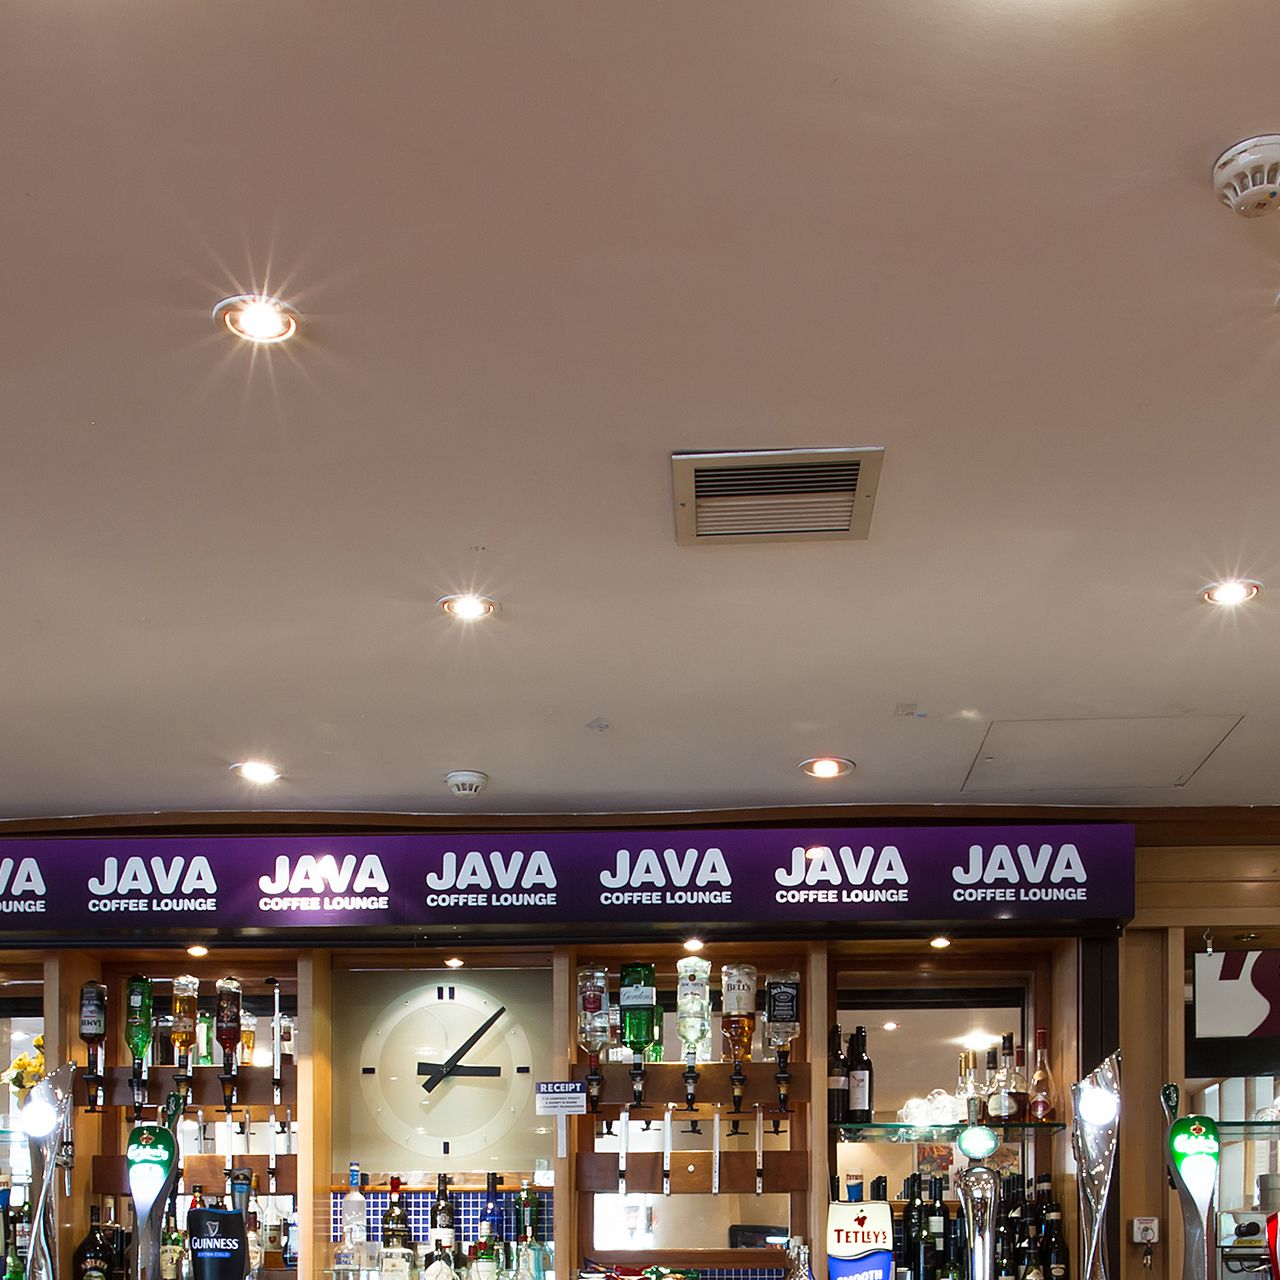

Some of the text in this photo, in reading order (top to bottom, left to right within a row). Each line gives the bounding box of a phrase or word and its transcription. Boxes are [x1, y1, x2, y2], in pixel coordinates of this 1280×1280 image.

[426, 851, 558, 890] JAVA
[600, 848, 732, 888] JAVA
[774, 845, 909, 886] JAVA
[952, 844, 1087, 884] JAVA
[88, 856, 218, 895] JAVA
[258, 854, 390, 894] JAVA
[426, 892, 557, 906] COFFEE LOUNGE
[600, 891, 732, 904] COFFEE LOUNGE
[775, 889, 908, 903] COFFEE LOUNGE
[952, 888, 1087, 901] COFFEE LOUNGE
[88, 898, 217, 912] COFFEE LOUNGE
[258, 896, 389, 910] COFFEE LOUNGE
[540, 1083, 582, 1093] RECEIPT
[192, 1236, 239, 1250] GUINNESS
[834, 1229, 887, 1244] TETLEY'S
